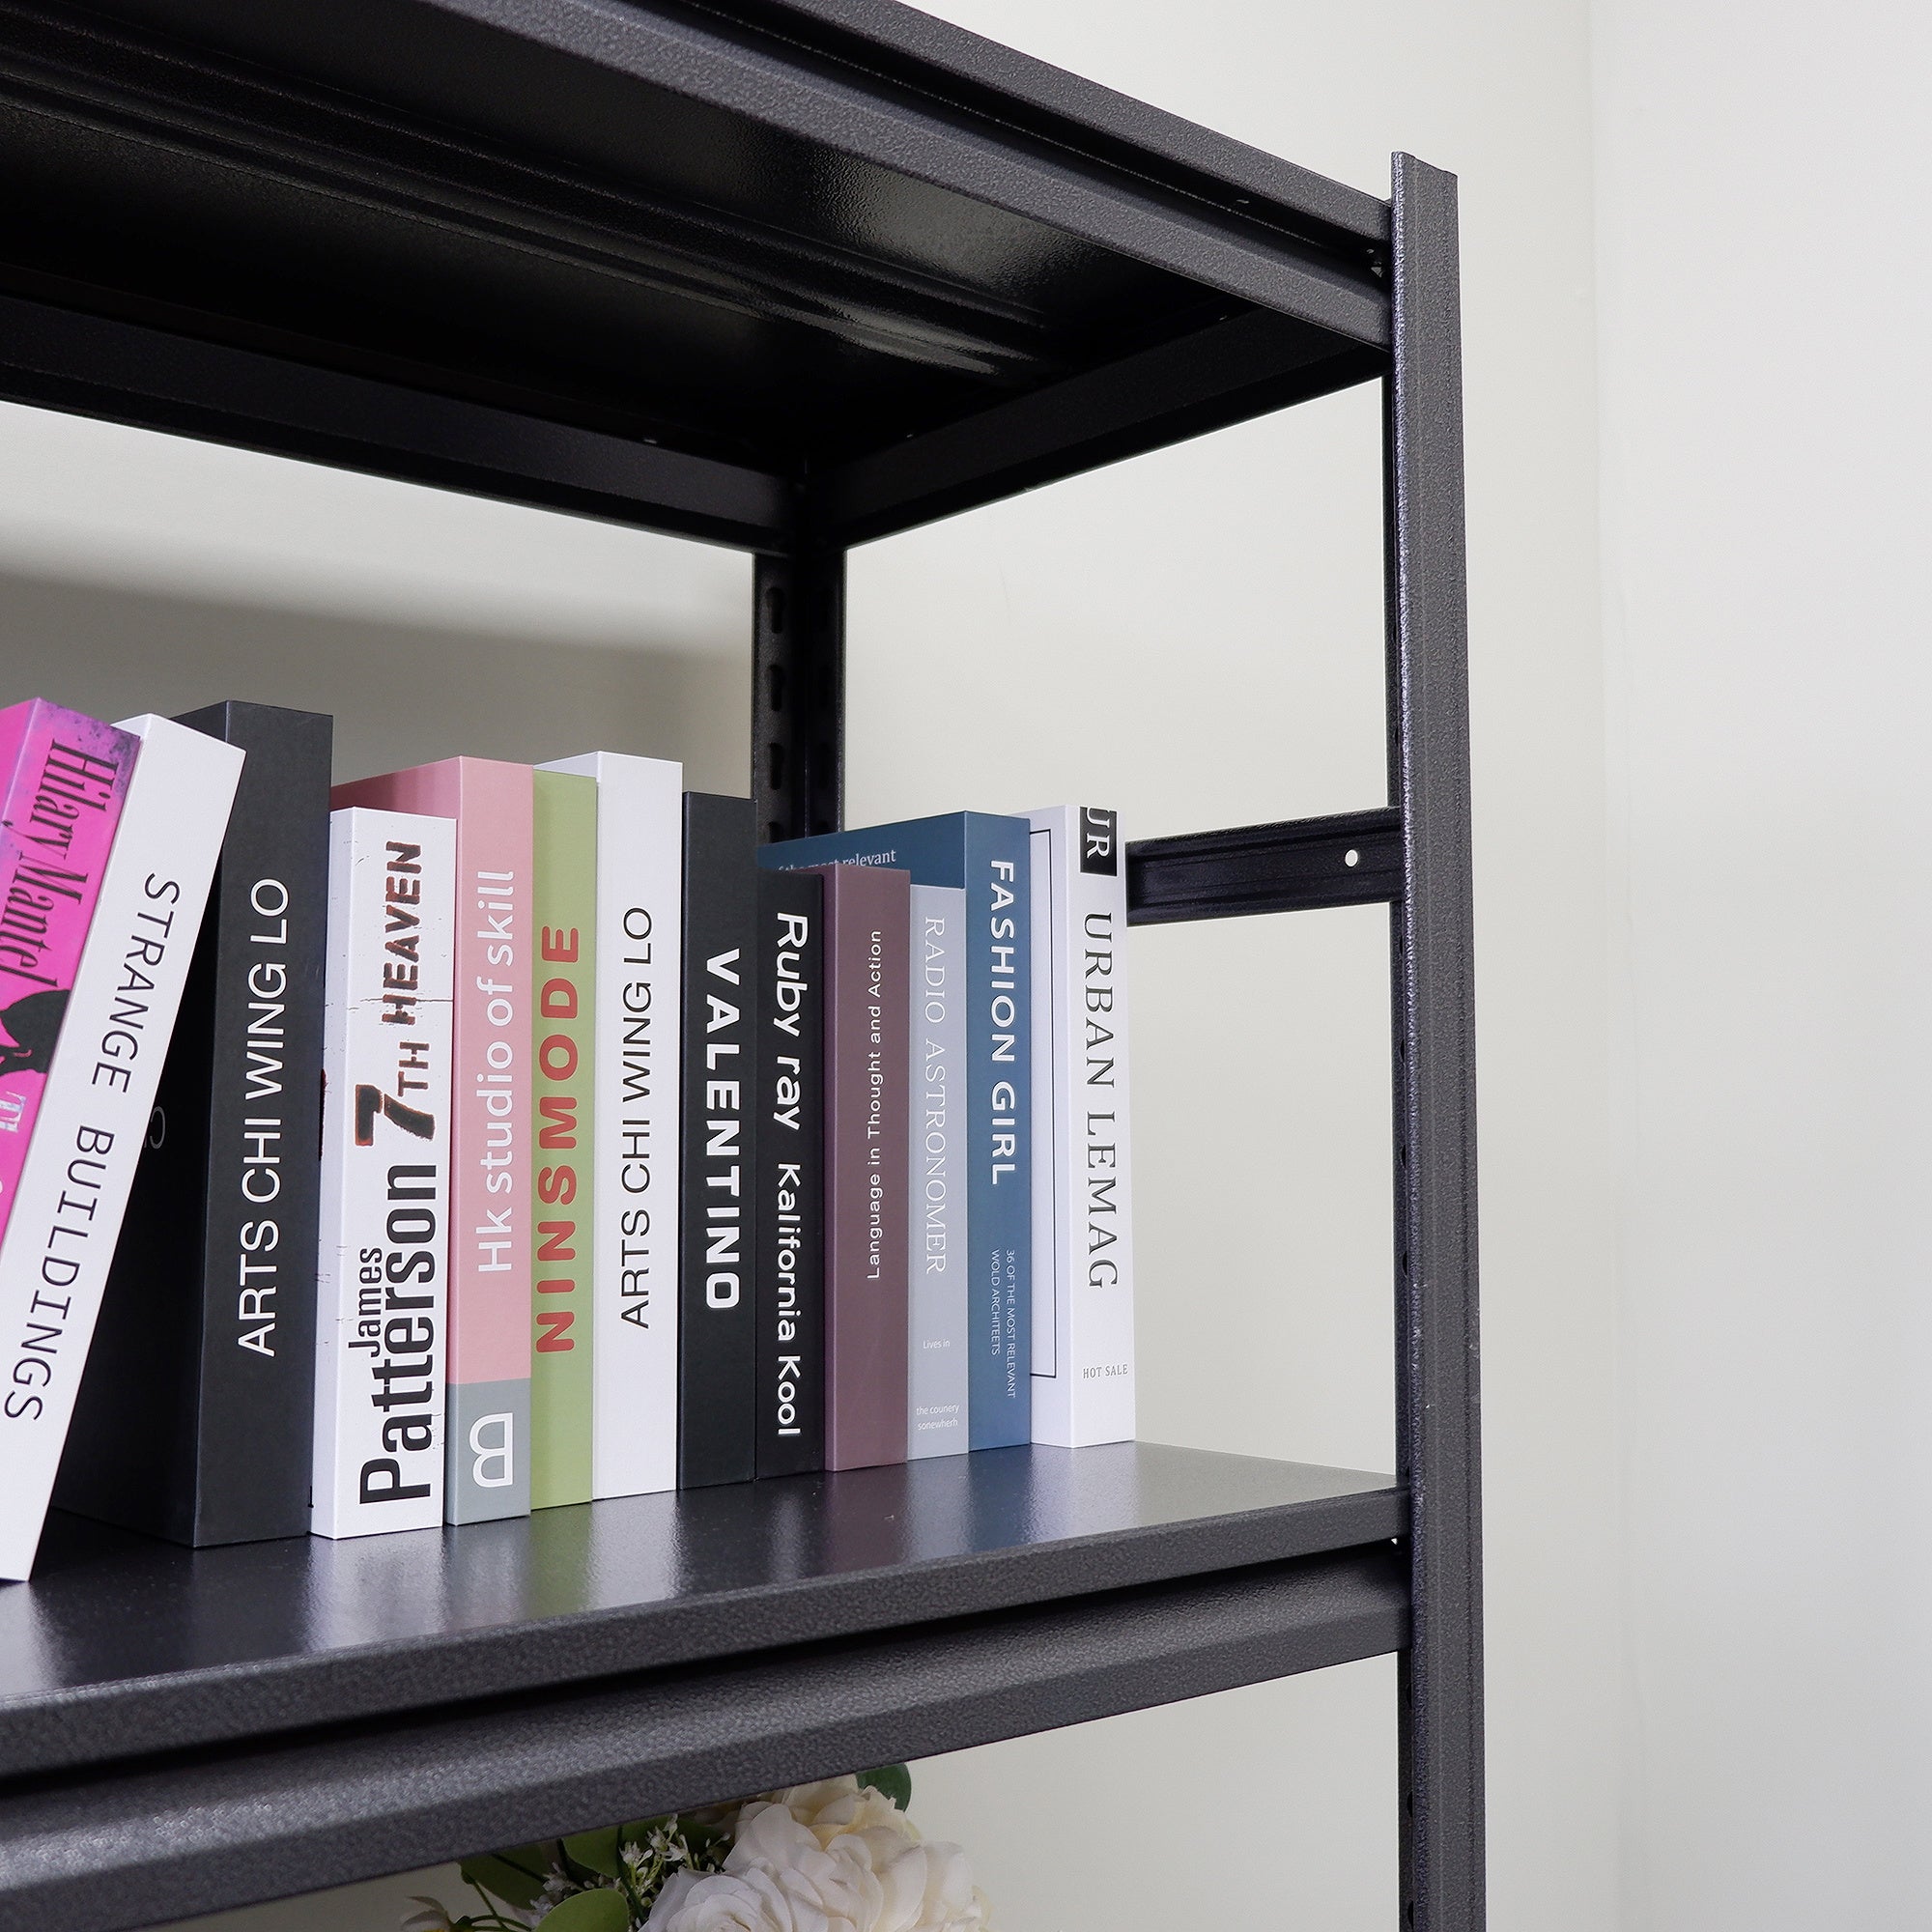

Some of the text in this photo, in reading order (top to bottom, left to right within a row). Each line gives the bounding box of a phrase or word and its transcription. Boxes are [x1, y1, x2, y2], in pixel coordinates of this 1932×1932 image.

[0, 738, 119, 987] Hilary Mantel
[381, 841, 422, 1026] HEAVEN
[774, 912, 809, 1131] Ruby ray
[989, 860, 1016, 1185] FASHION GIRL
[4, 873, 181, 1422] STRANGE BUILDINGS
[239, 878, 290, 1357] ARTS CHI WING LO
[476, 871, 515, 1272] Hk studio of skill
[535, 925, 580, 1353] NINSMODE
[620, 907, 653, 1330] ARTS CHI WING LO
[706, 948, 741, 1309] VALENTINO
[867, 929, 884, 1280] Language in Thought and Action
[924, 916, 948, 1275] RADIO ASTRONOMER
[1084, 912, 1118, 1290] URBAN LEMAG
[348, 1164, 438, 1506] James Patterson
[777, 1162, 802, 1436] Kalifornia Kool
[991, 1249, 1001, 1286] WOLD
[1006, 1249, 1016, 1398] 36 OF THE MOST RELEVANT
[1083, 1363, 1128, 1378] HOT SALE
